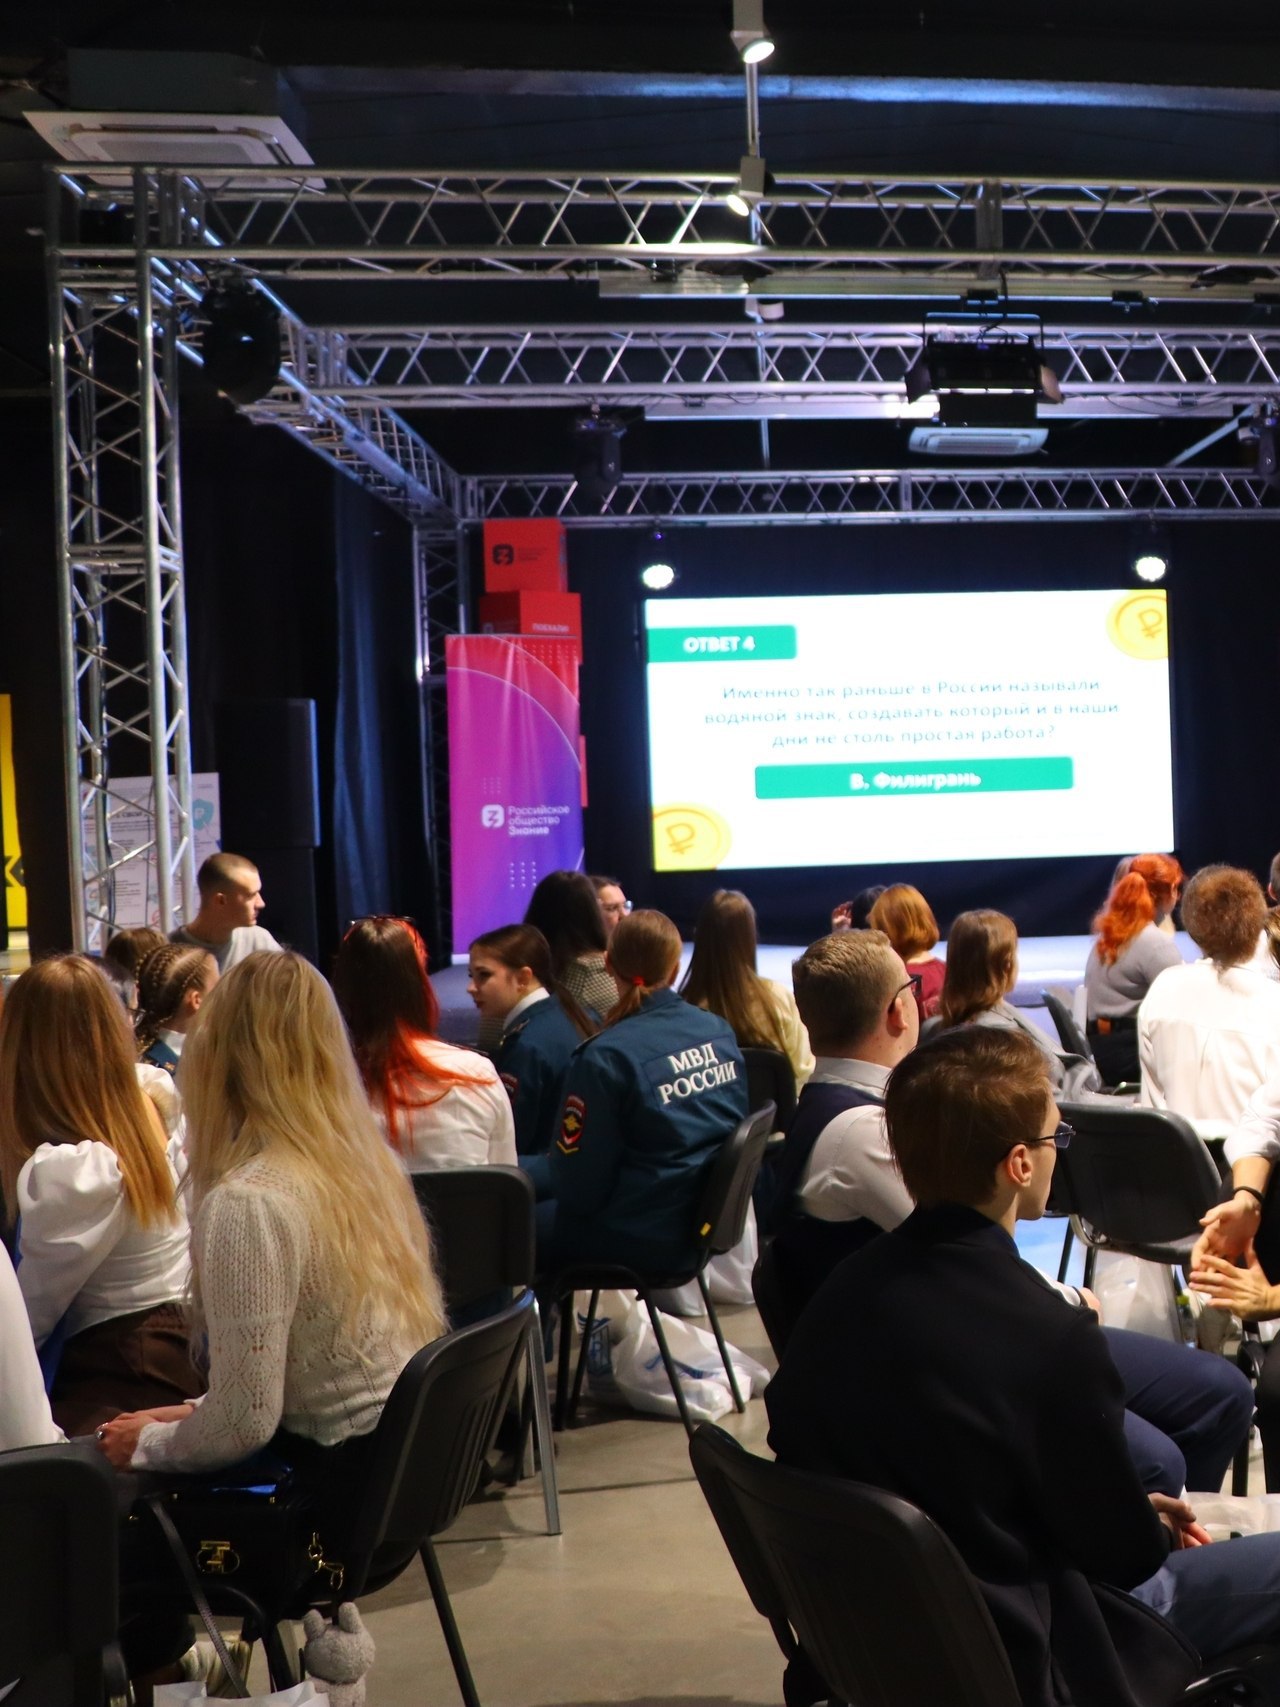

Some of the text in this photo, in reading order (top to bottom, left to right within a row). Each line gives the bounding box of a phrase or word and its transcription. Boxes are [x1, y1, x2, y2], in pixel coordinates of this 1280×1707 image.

[683, 635, 756, 653] ОТВЕТ 4
[723, 680, 1101, 699] Именно так раньше в России называли
[705, 702, 1121, 725] водяной знак, создавать который и в наши
[771, 724, 1056, 748] дни не столь простая работа?
[873, 771, 983, 791] Филигрань
[508, 805, 571, 816] Российское
[508, 815, 561, 826] общество
[508, 825, 550, 836] Знание
[667, 1042, 720, 1074] МВД
[657, 1060, 738, 1104] РОССИИ
